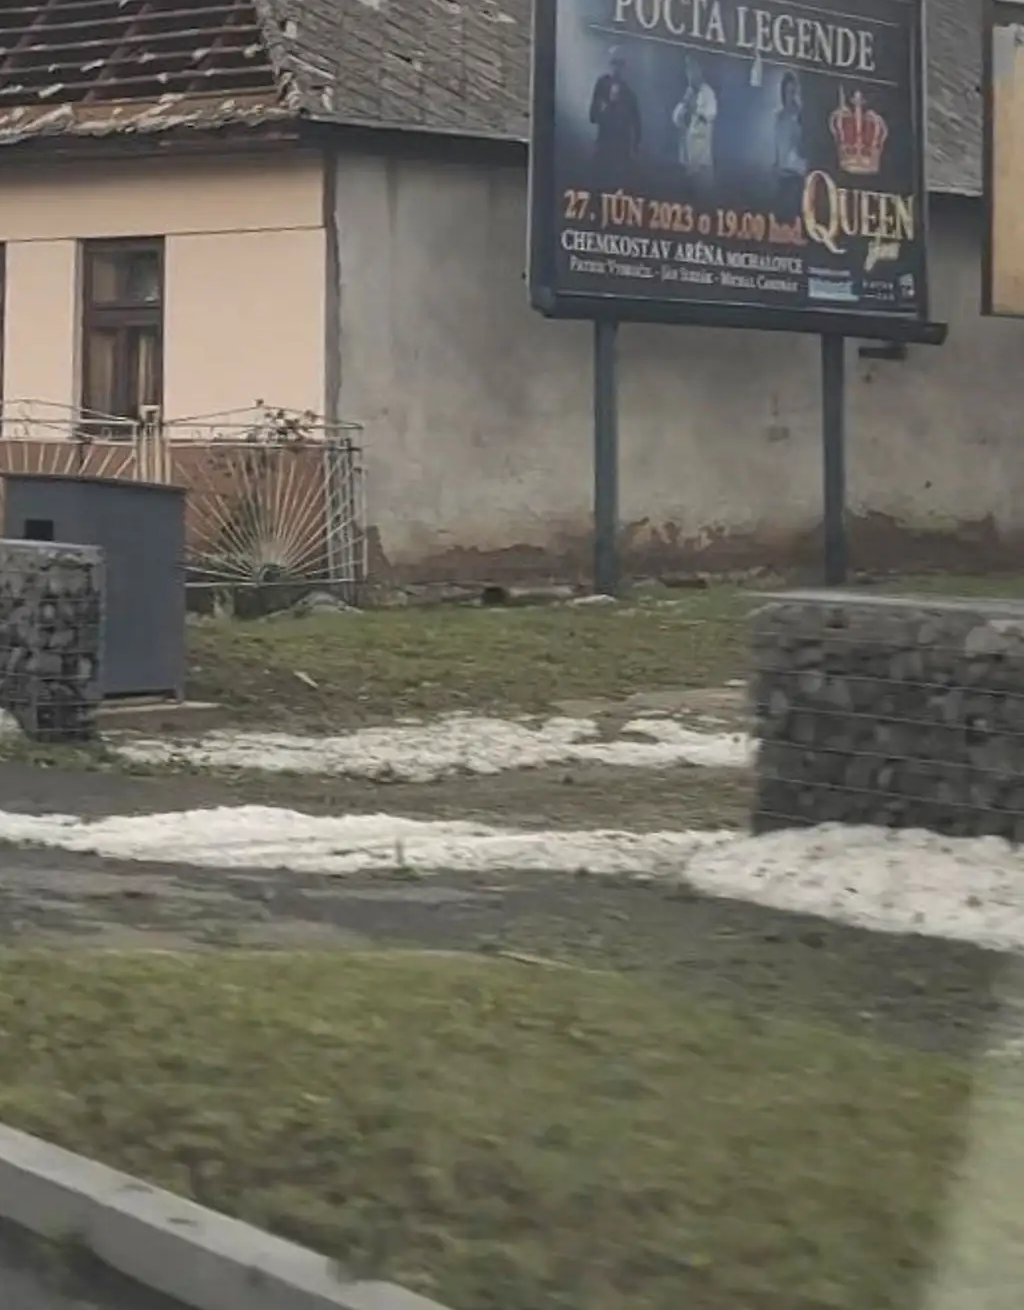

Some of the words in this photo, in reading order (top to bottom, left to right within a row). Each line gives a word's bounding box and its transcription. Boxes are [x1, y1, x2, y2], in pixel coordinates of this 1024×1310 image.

[737, 5, 875, 72] LEGENDE
[564, 190, 595, 220] 27.
[601, 189, 645, 228] JÚN
[648, 201, 693, 232] 2023
[716, 210, 765, 240] 19.00
[802, 169, 915, 254] QUEEN
[561, 229, 672, 259] CHEMKOSTAV
[675, 240, 724, 266] ARÉNA
